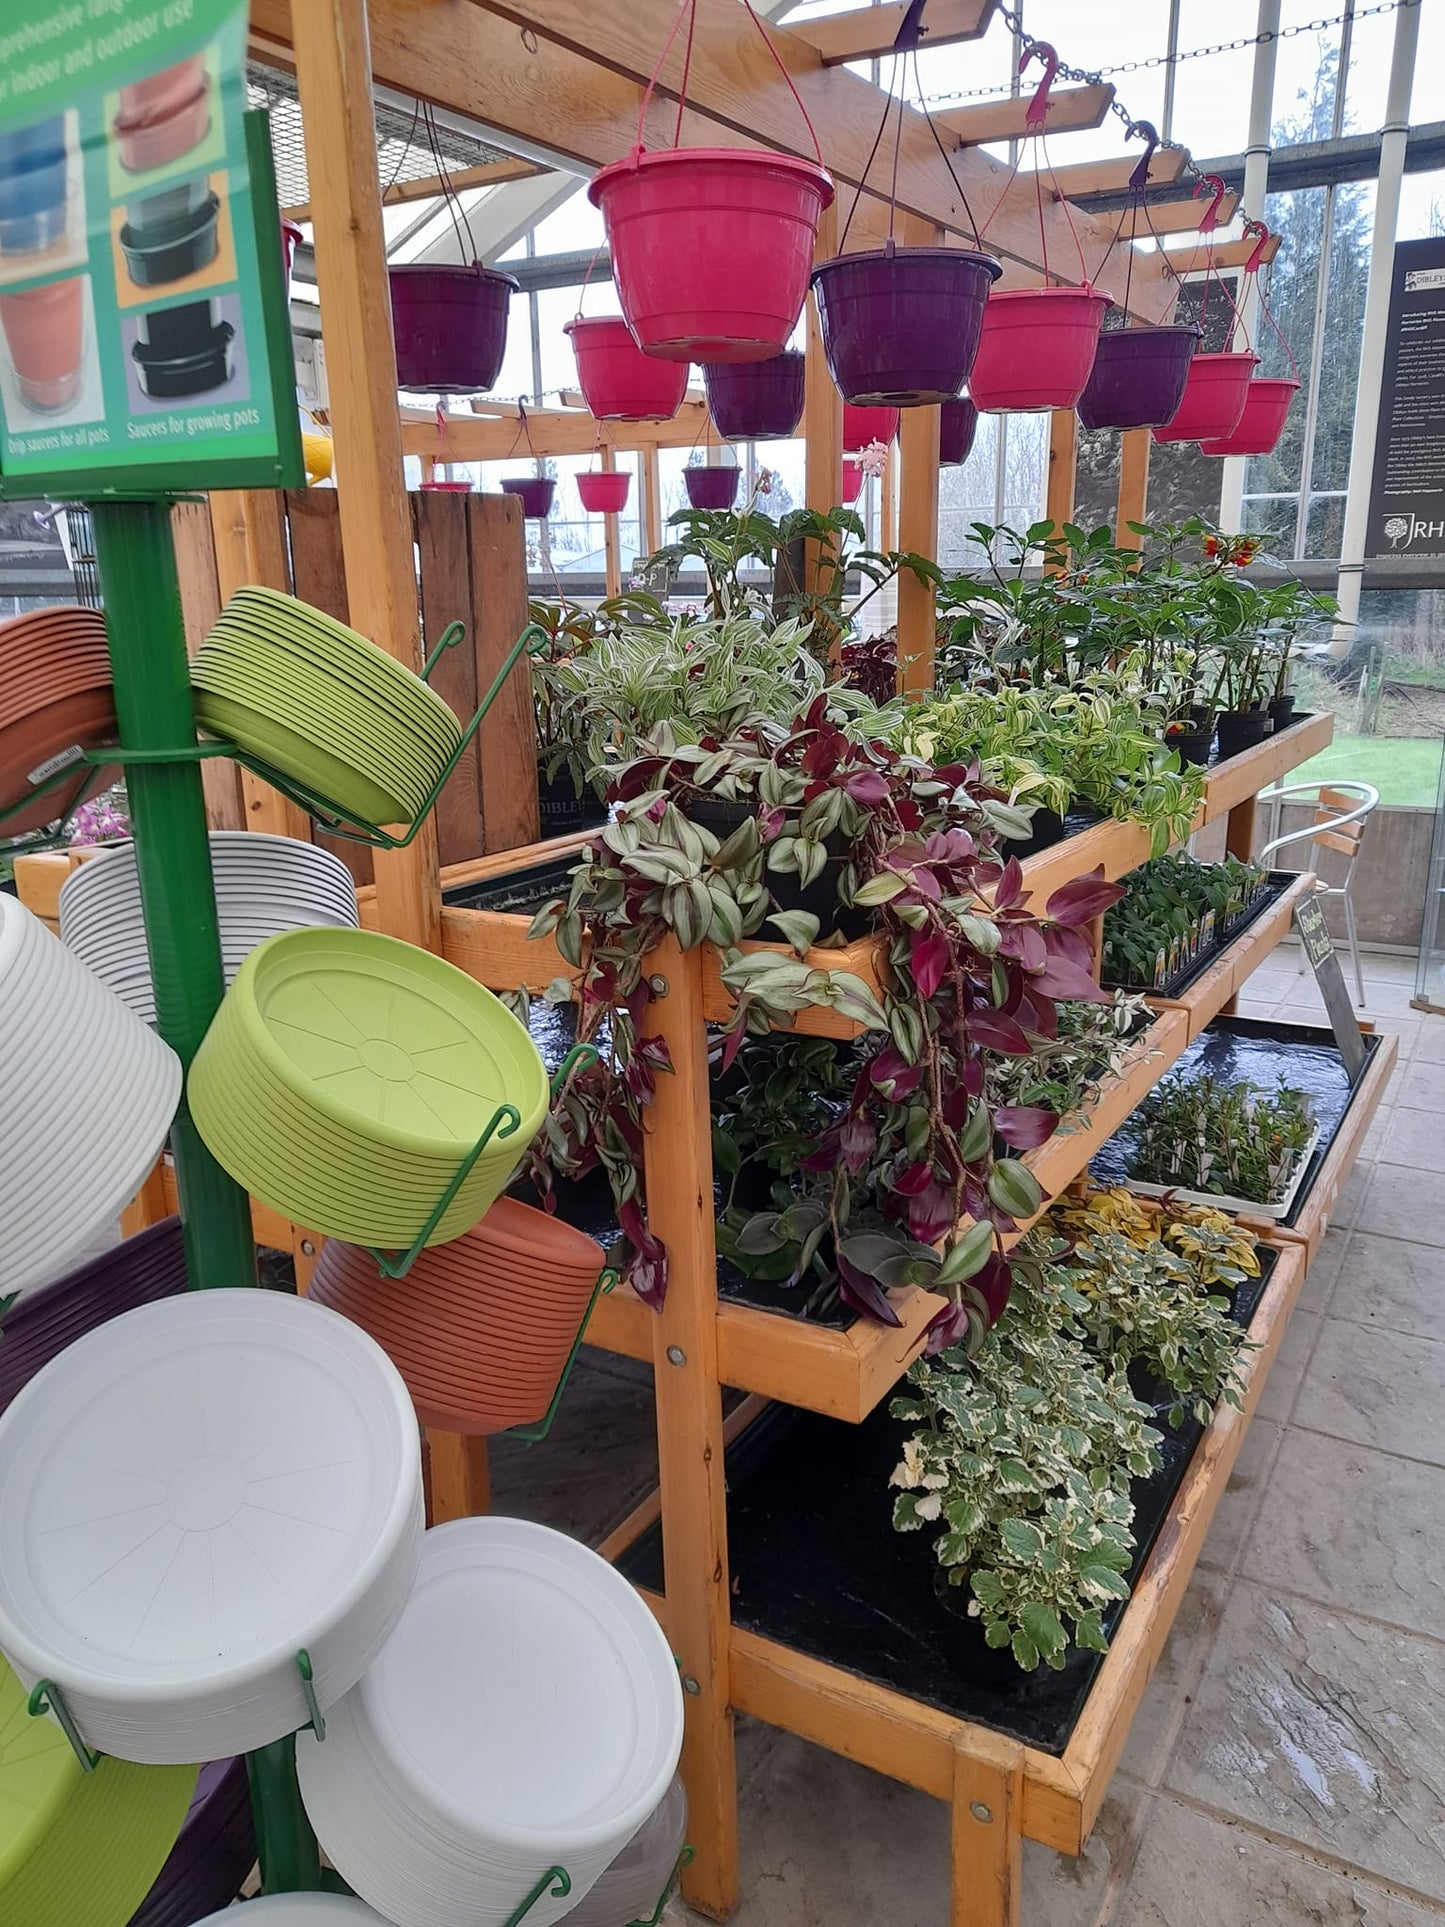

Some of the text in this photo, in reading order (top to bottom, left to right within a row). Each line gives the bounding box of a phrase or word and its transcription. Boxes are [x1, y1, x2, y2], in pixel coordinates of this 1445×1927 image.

[11, 59, 60, 96] indoor
[64, 36, 93, 76] and
[97, 11, 159, 61] outdoor
[163, 0, 193, 30] use
[126, 407, 261, 440] Saucers for growing pots
[60, 429, 74, 449] for
[74, 427, 88, 447] all
[87, 427, 110, 449] pots
[1414, 520, 1445, 539] RH
